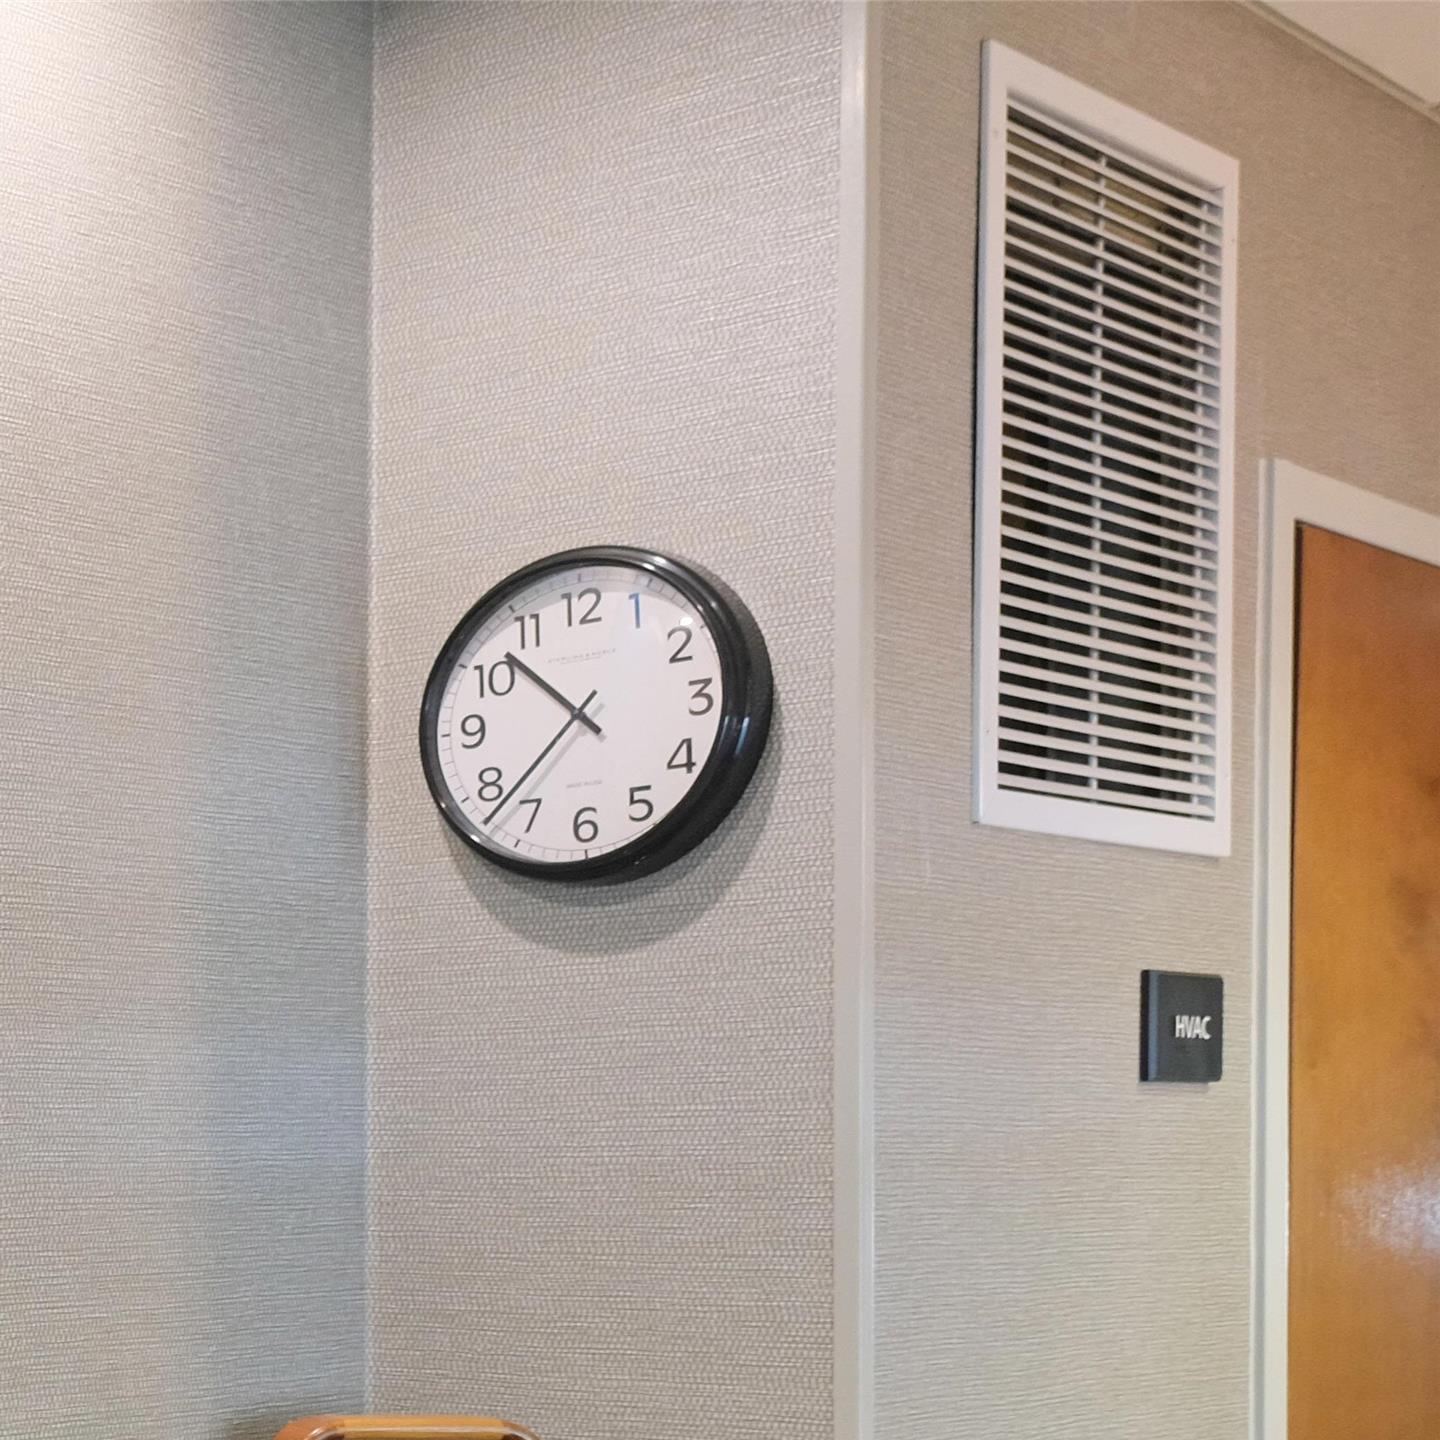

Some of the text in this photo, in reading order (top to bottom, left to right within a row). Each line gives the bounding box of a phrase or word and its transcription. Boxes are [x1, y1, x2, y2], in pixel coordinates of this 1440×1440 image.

[561, 588, 602, 627] 12
[628, 593, 641, 629] 1
[514, 613, 540, 650] 11
[666, 625, 693, 664] 2
[473, 660, 516, 698] 10
[688, 678, 714, 715] 3
[460, 714, 486, 749] 9
[666, 737, 696, 774] 4
[477, 767, 503, 801] 8
[519, 798, 542, 833] 7
[628, 785, 654, 822] 5
[573, 807, 599, 843] 6
[1175, 1014, 1212, 1040] HVAC
